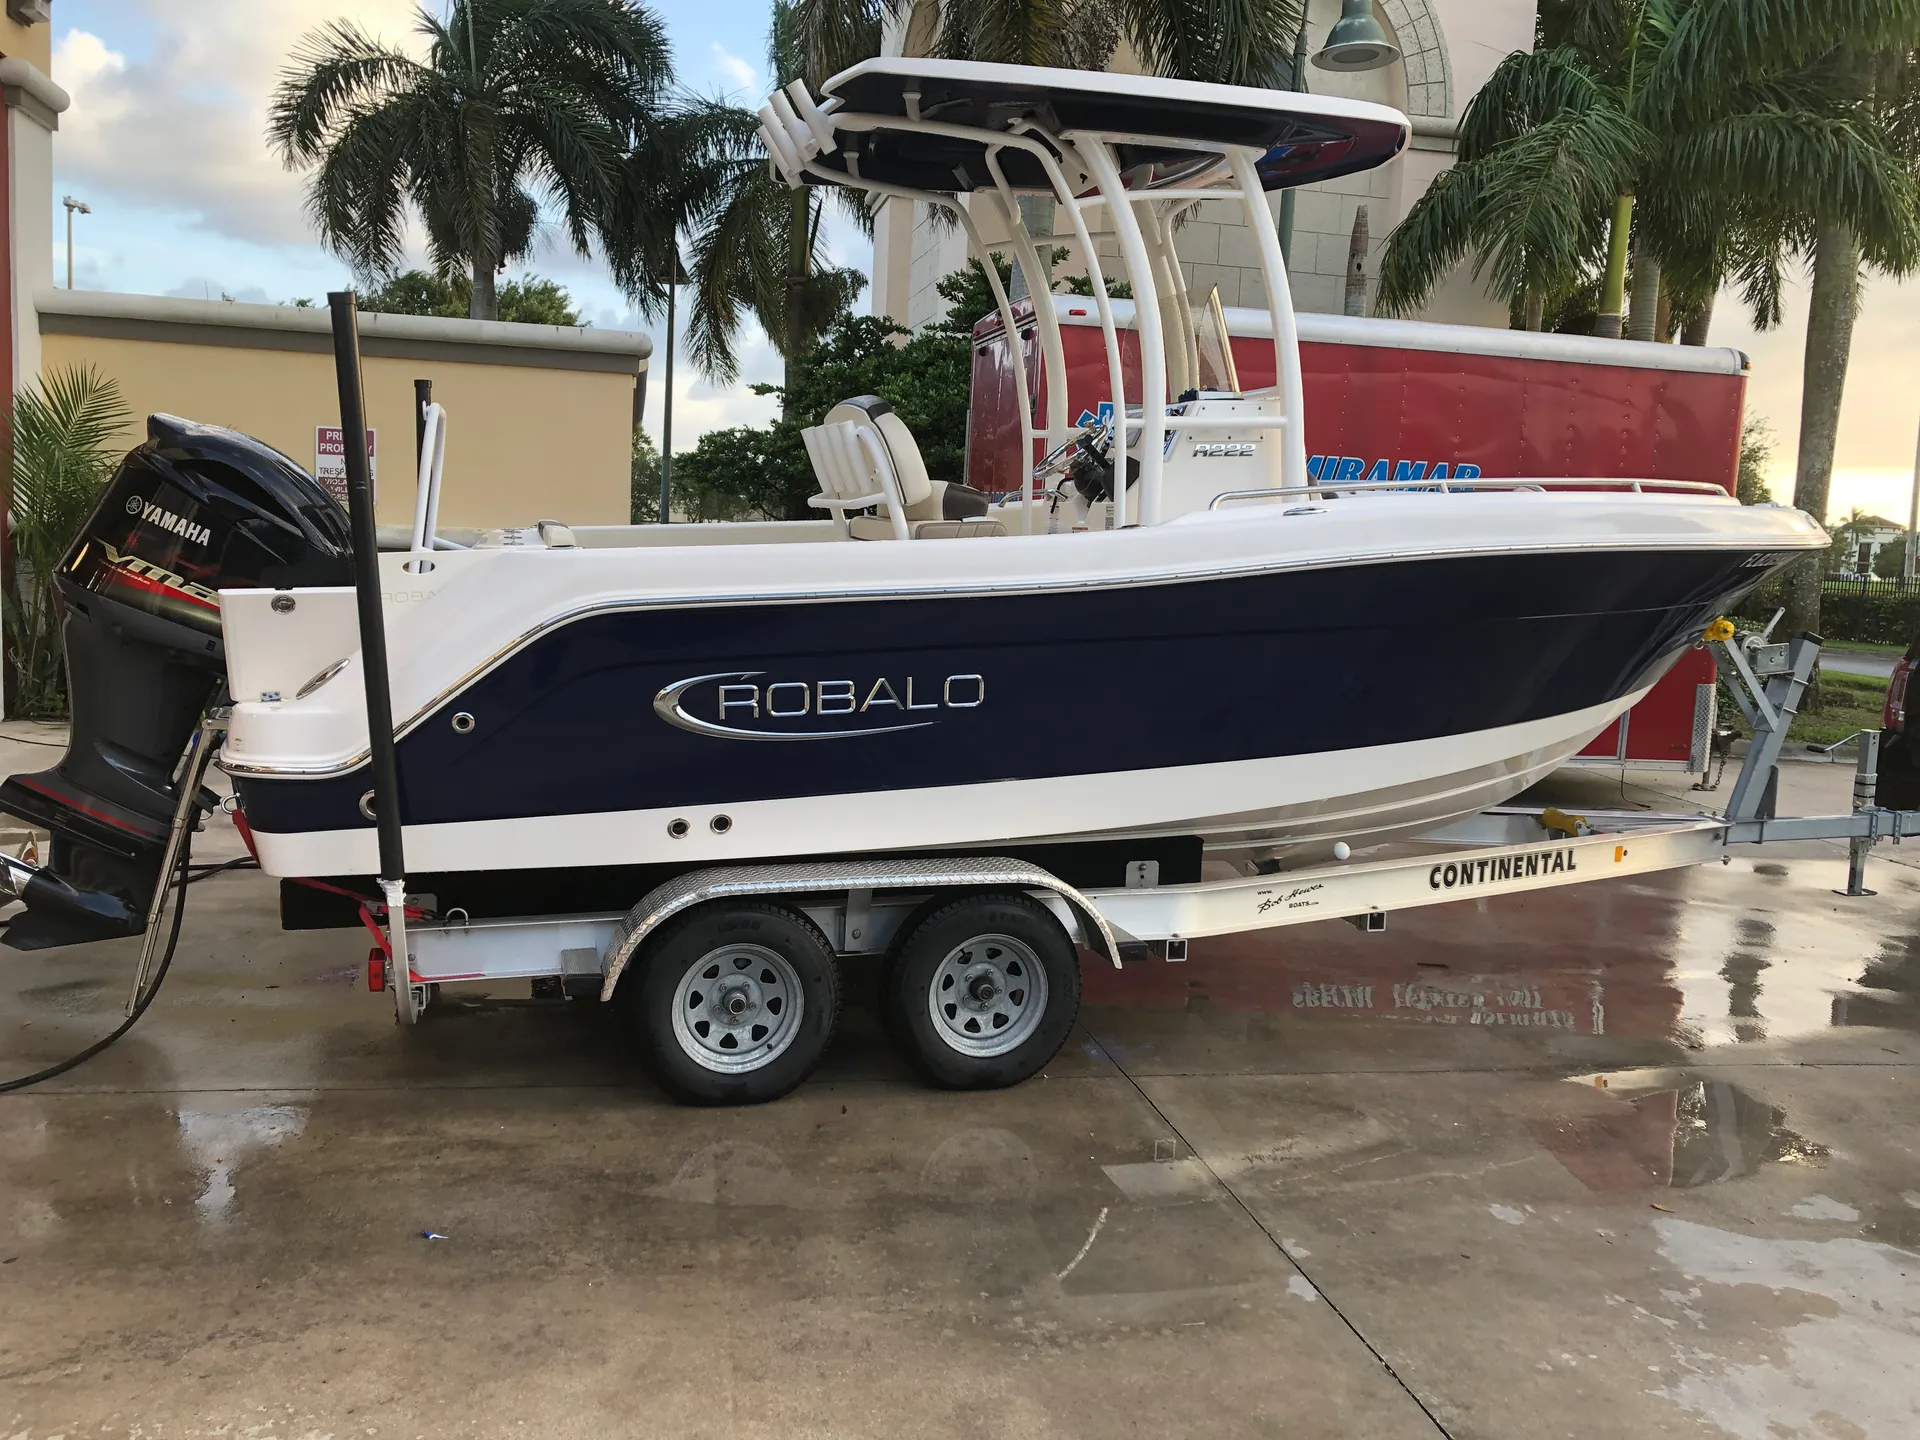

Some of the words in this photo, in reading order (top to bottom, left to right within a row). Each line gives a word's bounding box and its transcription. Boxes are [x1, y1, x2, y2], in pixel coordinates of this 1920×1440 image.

[1192, 443, 1256, 457] R222
[141, 501, 211, 547] YAMAHA
[380, 590, 436, 603] ROBA
[718, 674, 985, 721] ROBALO
[1429, 848, 1577, 891] CONTINENTAL
